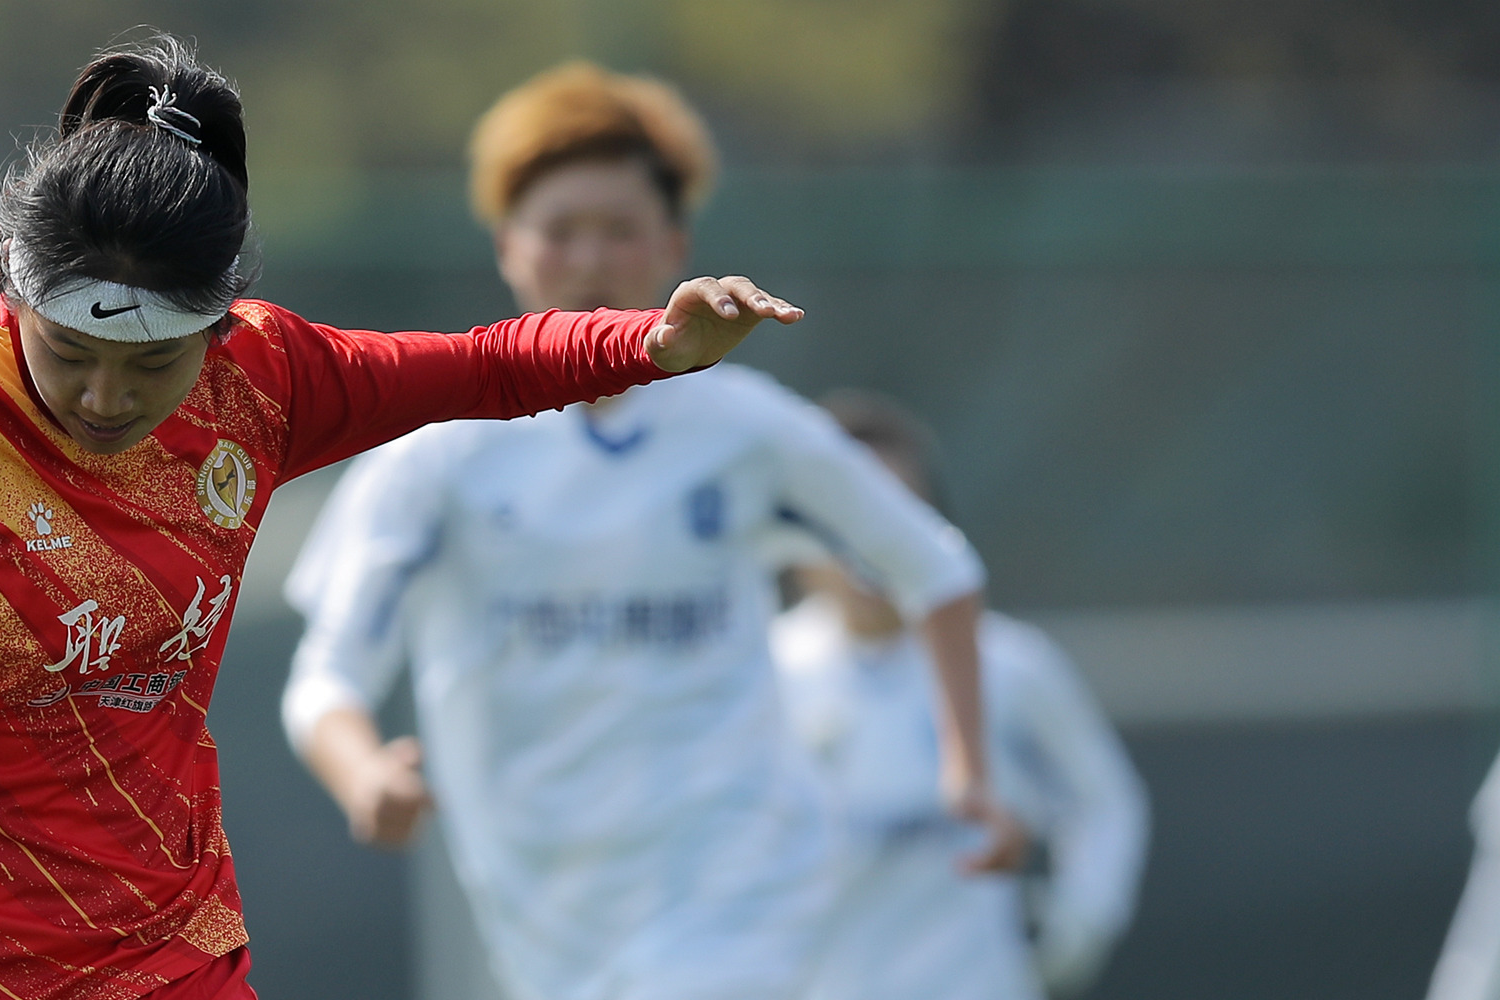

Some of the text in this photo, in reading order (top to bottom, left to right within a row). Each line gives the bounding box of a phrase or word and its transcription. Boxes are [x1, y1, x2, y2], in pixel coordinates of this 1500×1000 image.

[236, 448, 253, 470] CLUB
[26, 535, 73, 552] KELME
[99, 695, 159, 712] 天津红旗路
